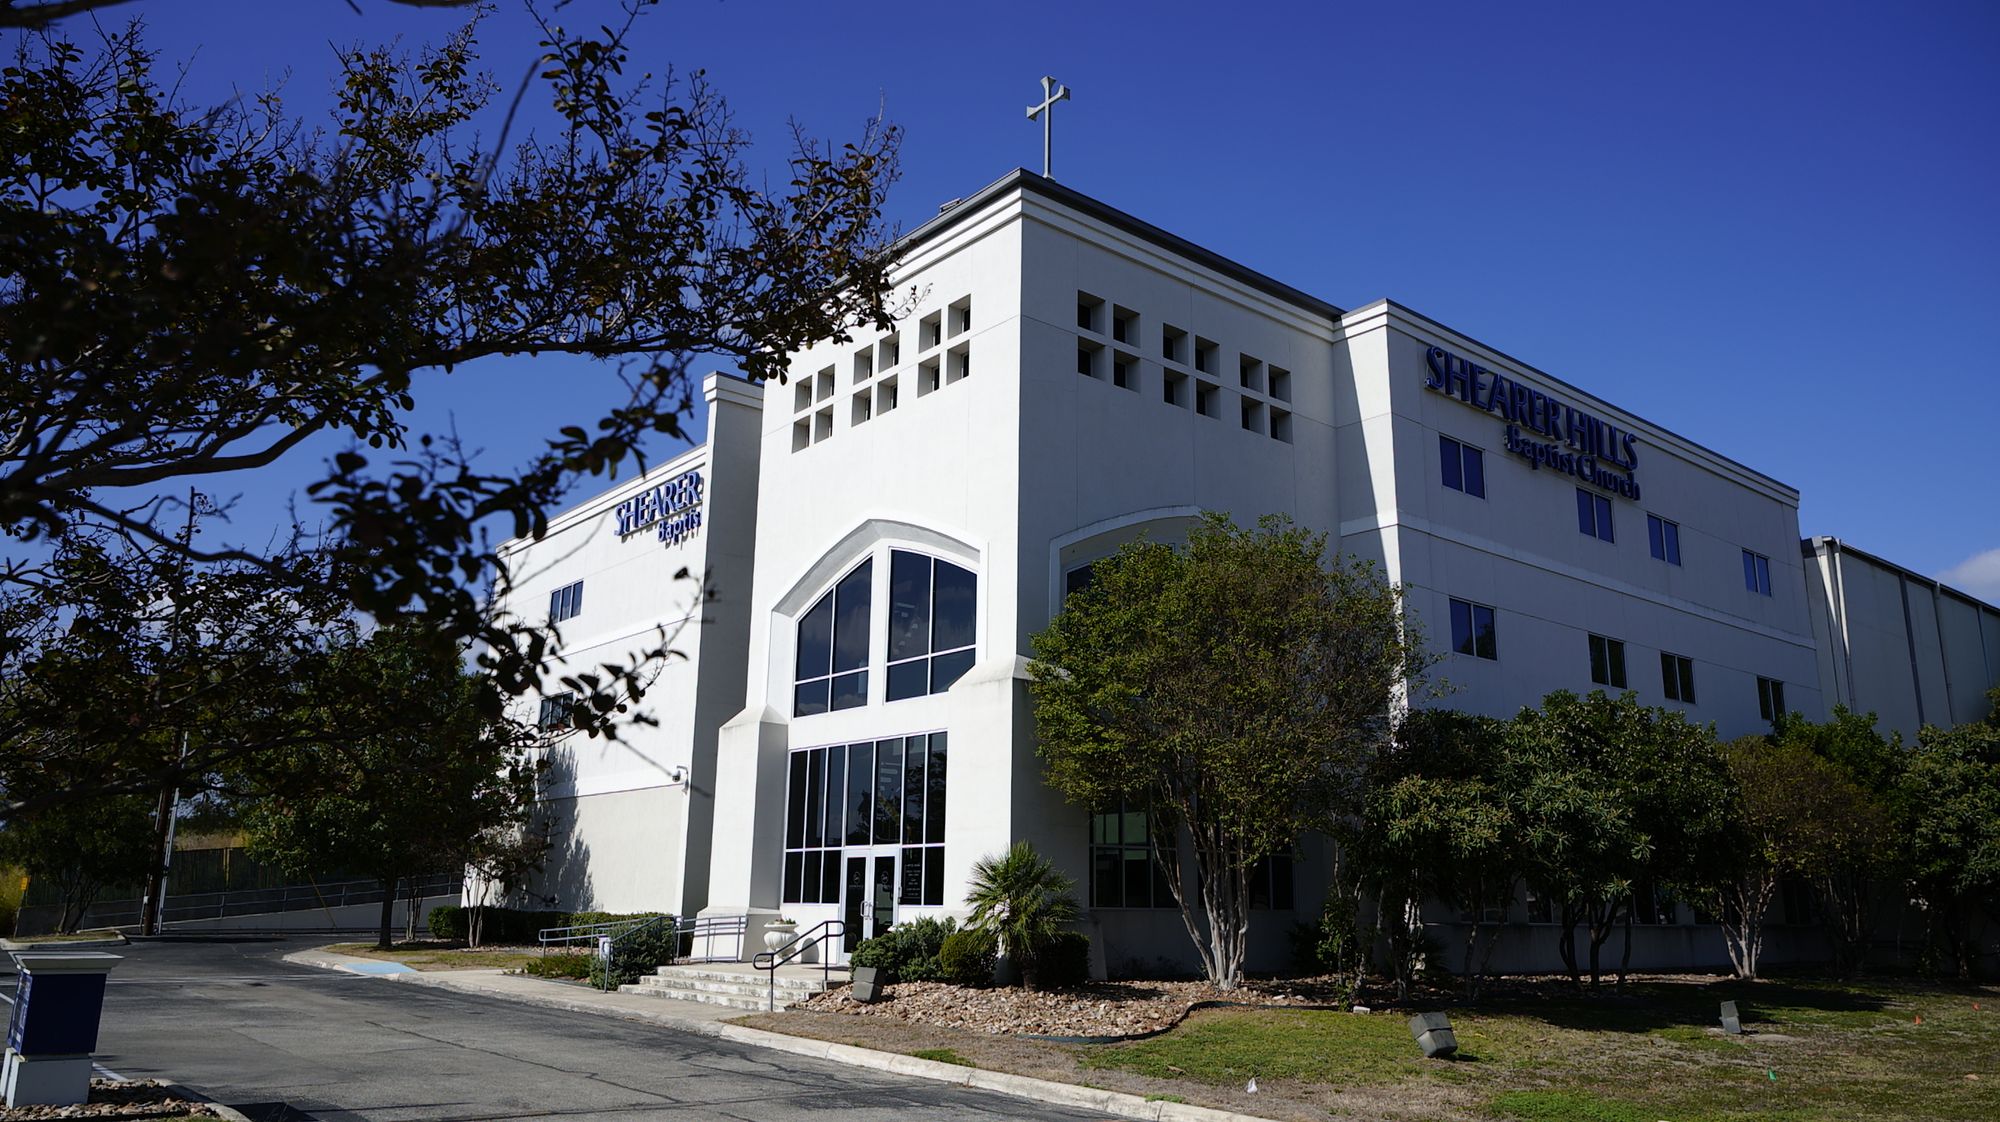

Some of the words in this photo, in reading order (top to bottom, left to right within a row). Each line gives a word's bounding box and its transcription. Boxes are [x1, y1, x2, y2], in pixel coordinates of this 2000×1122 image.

[1425, 347, 1563, 440] SHEARER
[1565, 407, 1638, 470] HILLS
[1504, 425, 1575, 475] Baptist
[1576, 454, 1640, 501] Church
[614, 472, 701, 536] SHEARER
